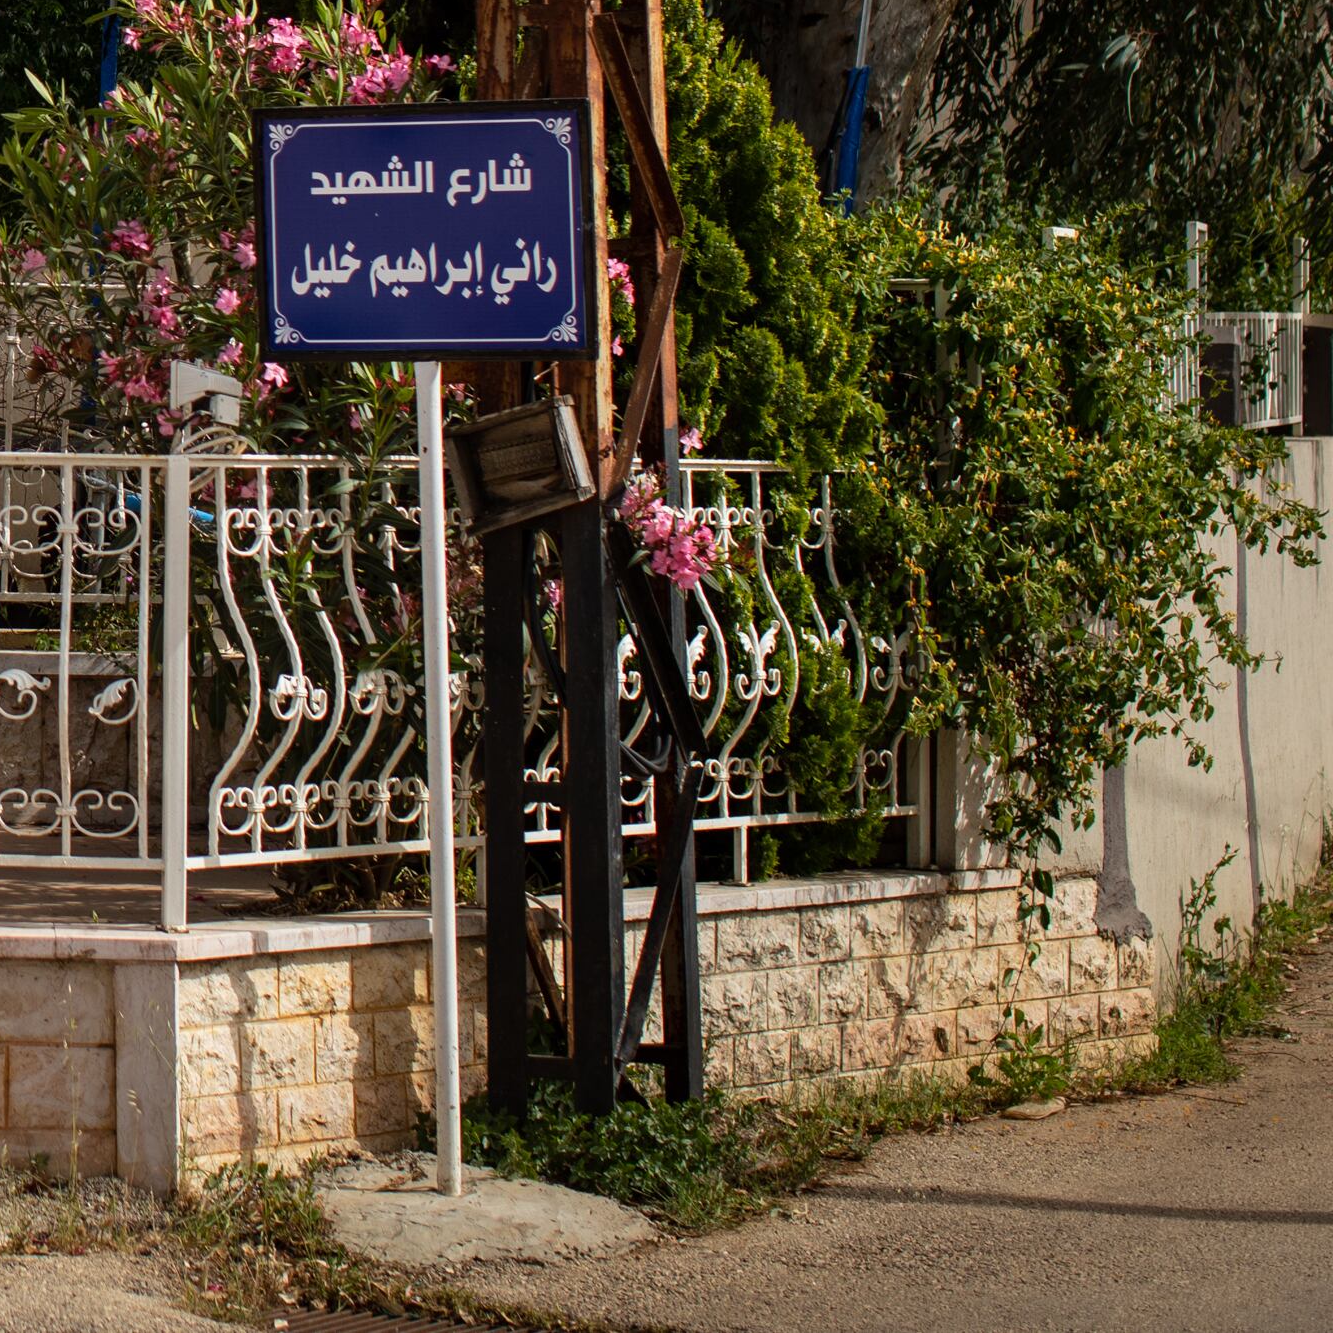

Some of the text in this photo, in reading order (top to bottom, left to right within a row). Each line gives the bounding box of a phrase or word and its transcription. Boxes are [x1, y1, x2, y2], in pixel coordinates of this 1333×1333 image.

[310, 152, 532, 207] شارع الشهيد
[291, 237, 558, 305] راني إبراهيم خليل
